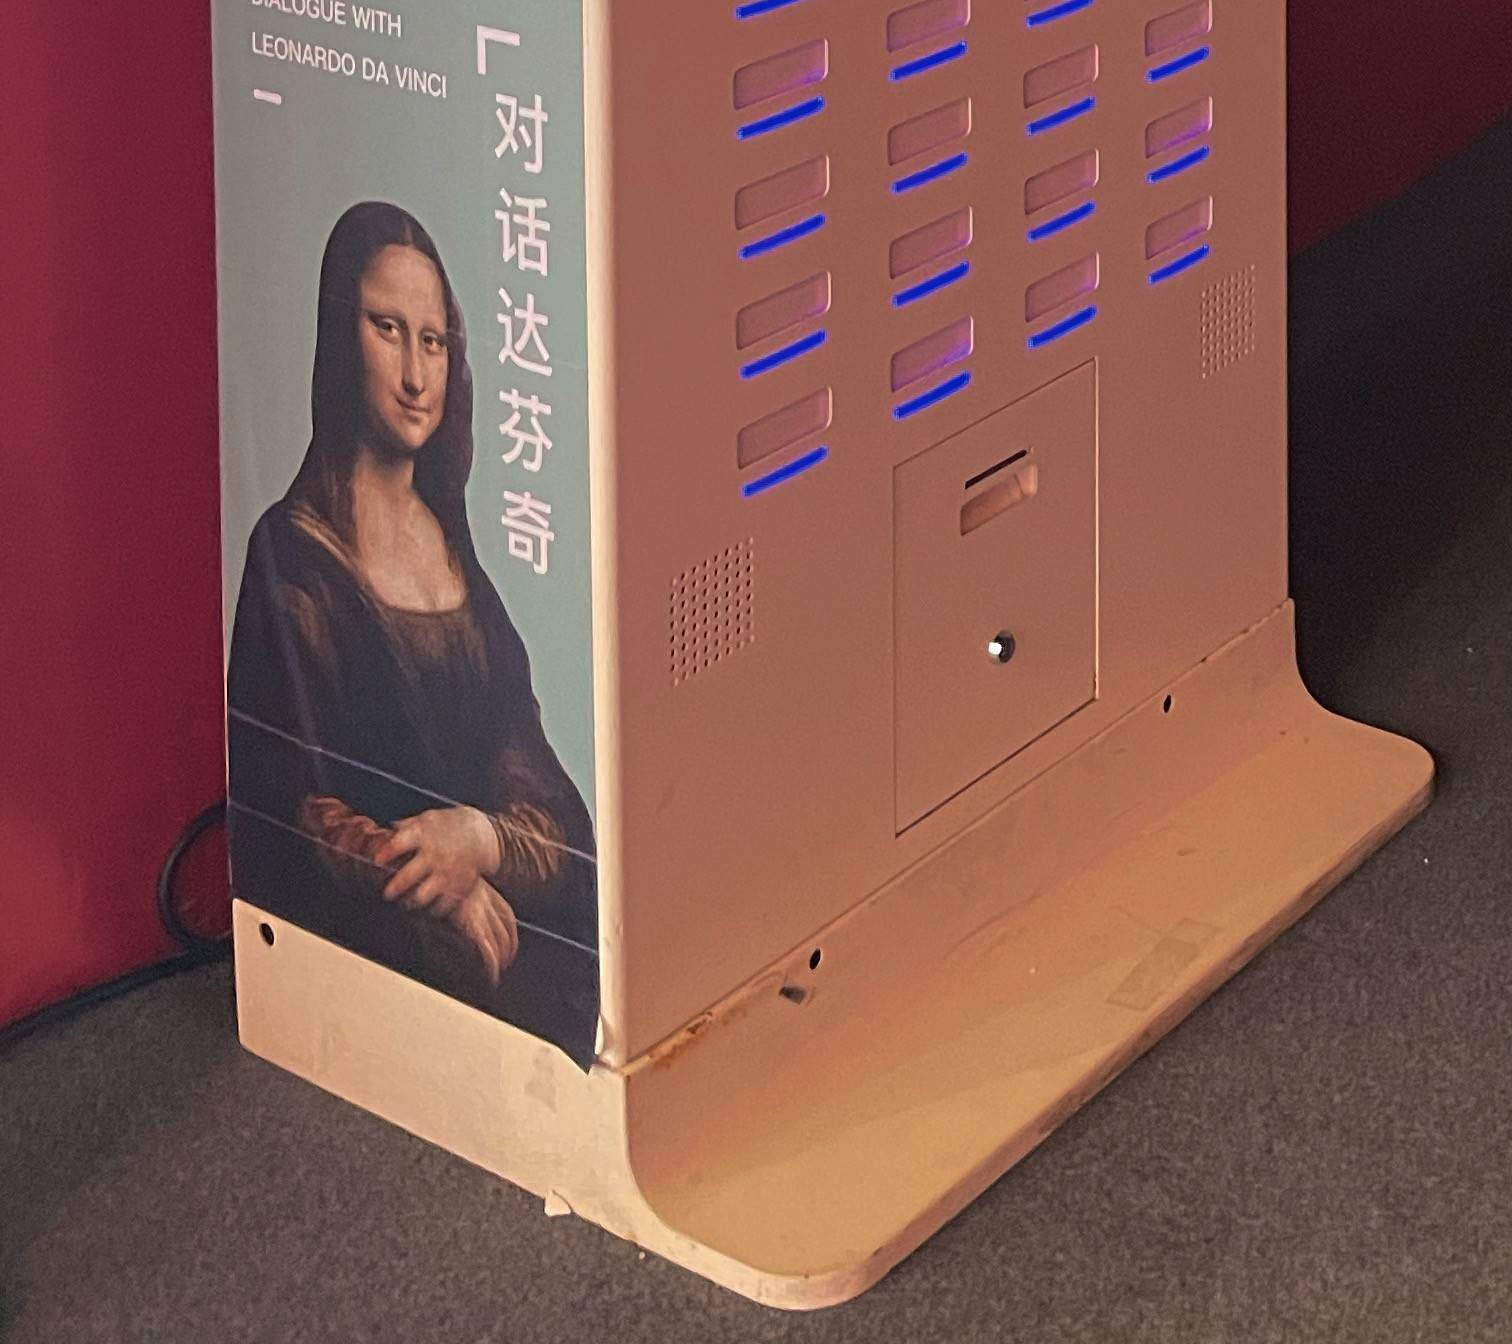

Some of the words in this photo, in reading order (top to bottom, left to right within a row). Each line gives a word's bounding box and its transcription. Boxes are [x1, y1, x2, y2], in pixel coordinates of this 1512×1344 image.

[352, 4, 402, 38] WITH
[252, 31, 356, 76] LEONARDO
[362, 57, 389, 85] DA
[395, 64, 447, 98] VINCI
